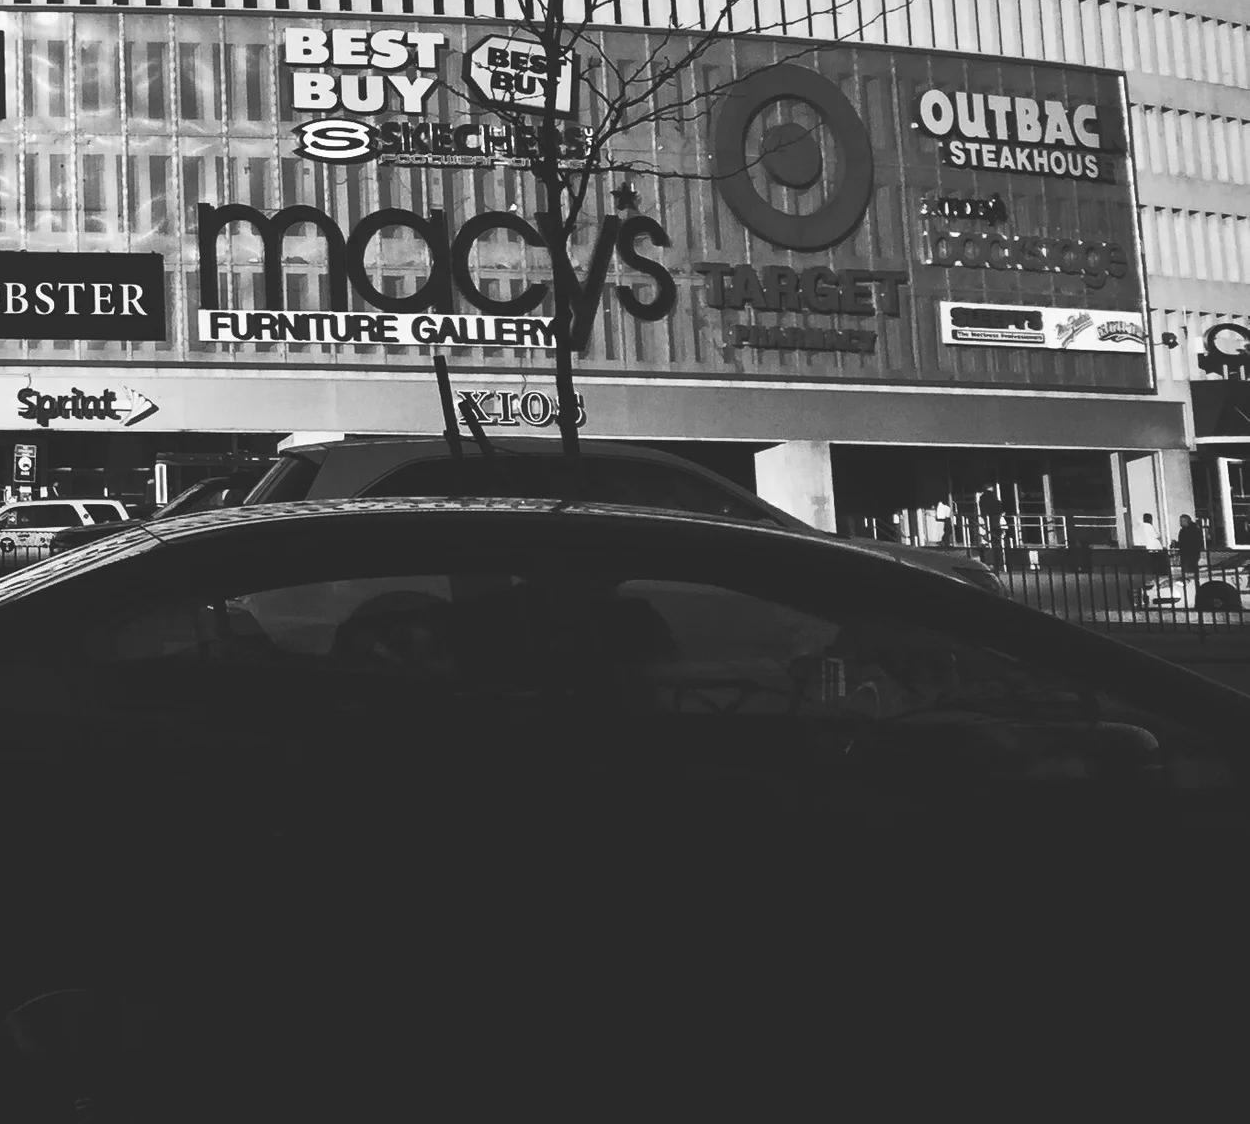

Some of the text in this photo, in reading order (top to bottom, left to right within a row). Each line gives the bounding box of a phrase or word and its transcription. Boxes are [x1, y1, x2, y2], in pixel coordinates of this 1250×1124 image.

[285, 27, 445, 69] BEST
[293, 72, 439, 113] BUY
[693, 262, 910, 318] TARGET
[208, 311, 557, 347] FURNITURE GALLERY
[17, 387, 121, 427] Sprint
